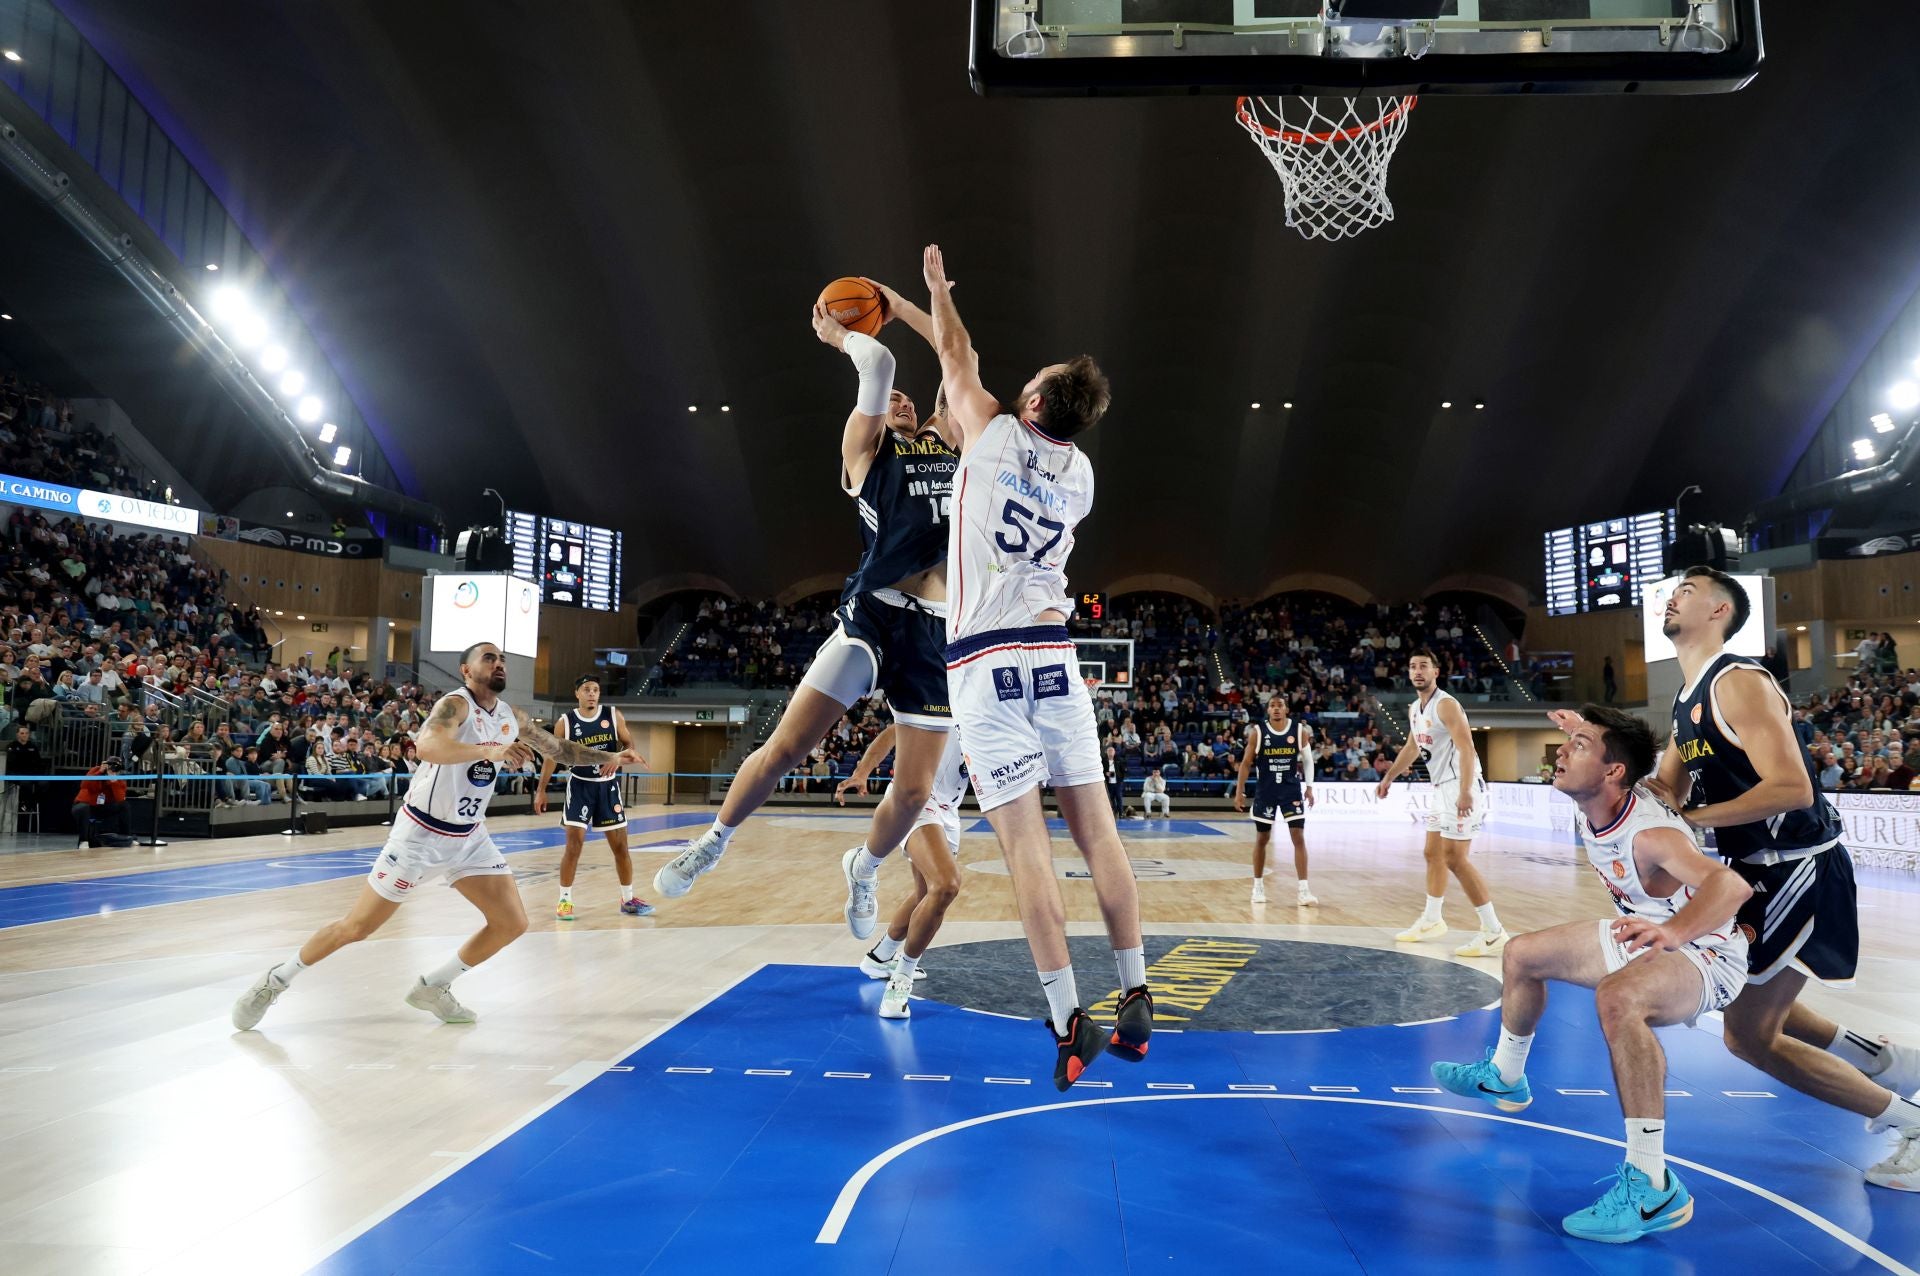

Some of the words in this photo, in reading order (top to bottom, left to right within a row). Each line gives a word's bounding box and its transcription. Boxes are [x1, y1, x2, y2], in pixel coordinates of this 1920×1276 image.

[917, 462, 956, 473] OVIEDO
[11, 483, 72, 504] CAMINO
[121, 499, 187, 523] OVIEDO
[929, 496, 951, 523] 14
[995, 499, 1065, 562] 57
[1083, 594, 1099, 604] 6.2
[1092, 604, 1102, 618] 9
[1043, 670, 1063, 680] DEPORTE
[923, 704, 951, 713] ALIMERK
[1264, 747, 1296, 756] ALIMERKA
[990, 765, 1014, 780] HEY,
[1275, 772, 1283, 784] 5
[457, 796, 483, 817] 23
